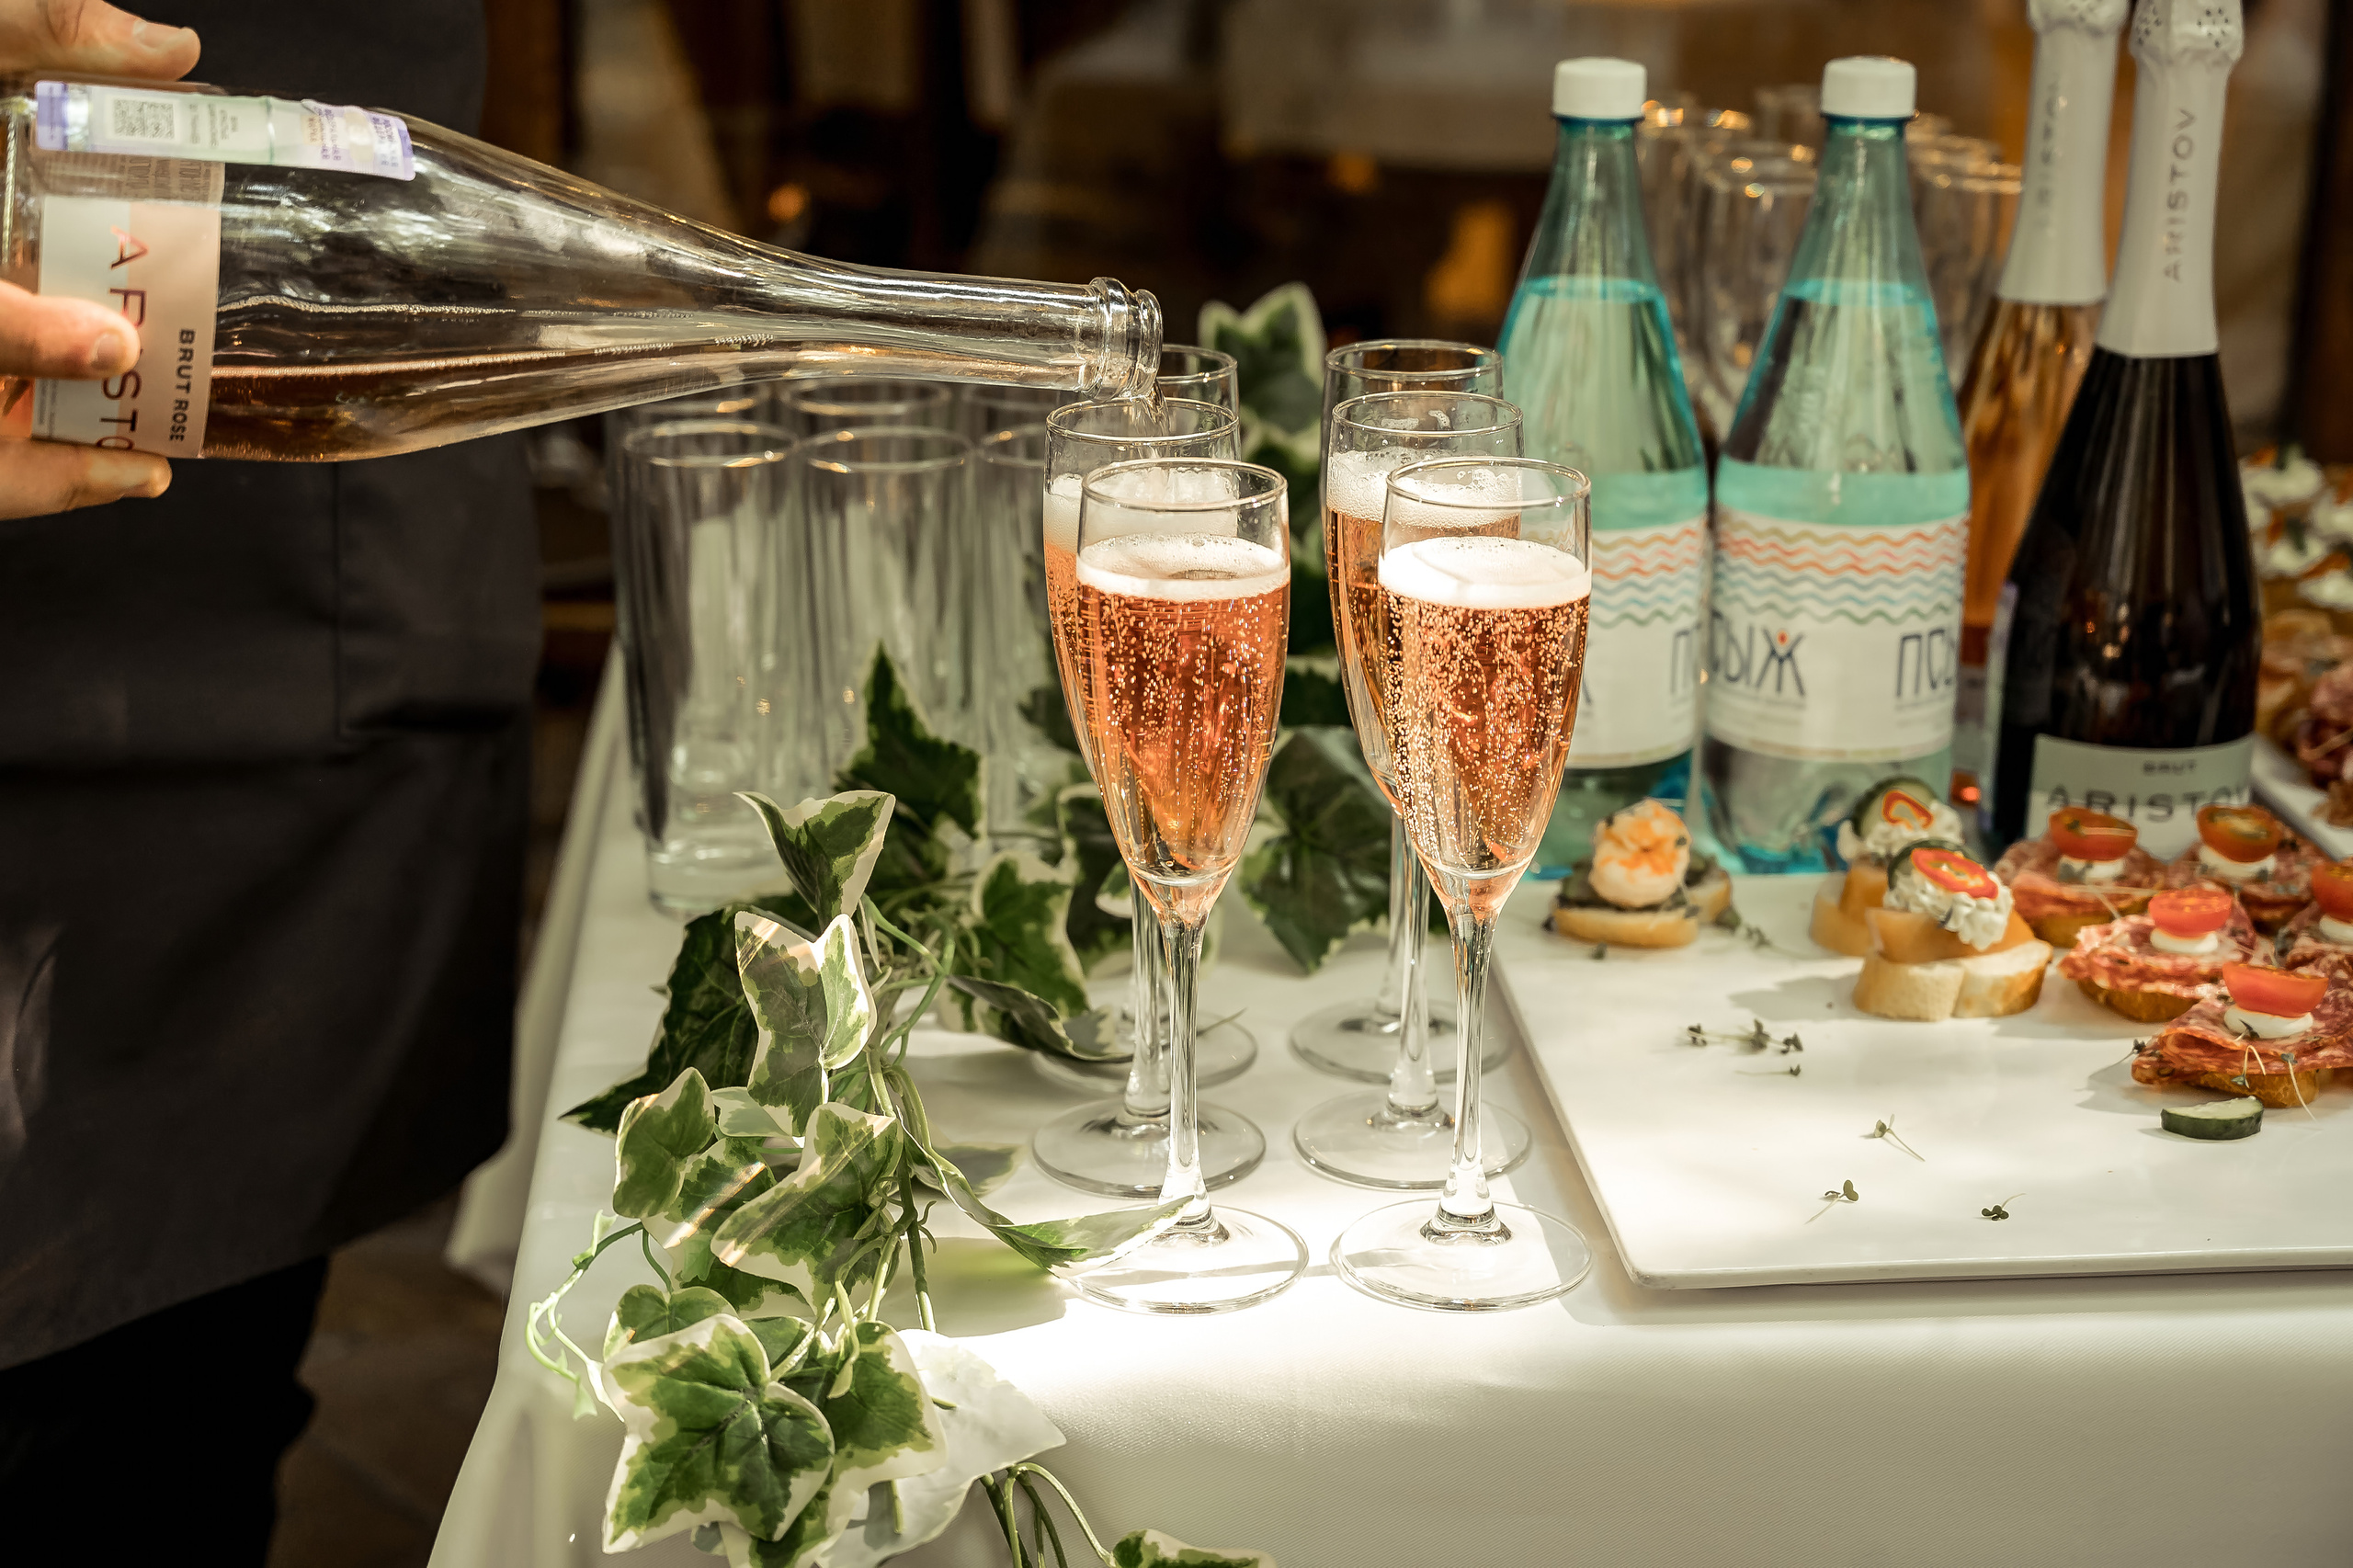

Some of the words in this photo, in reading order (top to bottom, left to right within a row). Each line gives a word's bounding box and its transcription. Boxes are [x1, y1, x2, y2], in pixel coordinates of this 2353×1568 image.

[2162, 108, 2198, 284] ARISTOV
[95, 225, 149, 450] ARSTO
[176, 328, 196, 394] BRUT
[168, 399, 189, 443] ROSE
